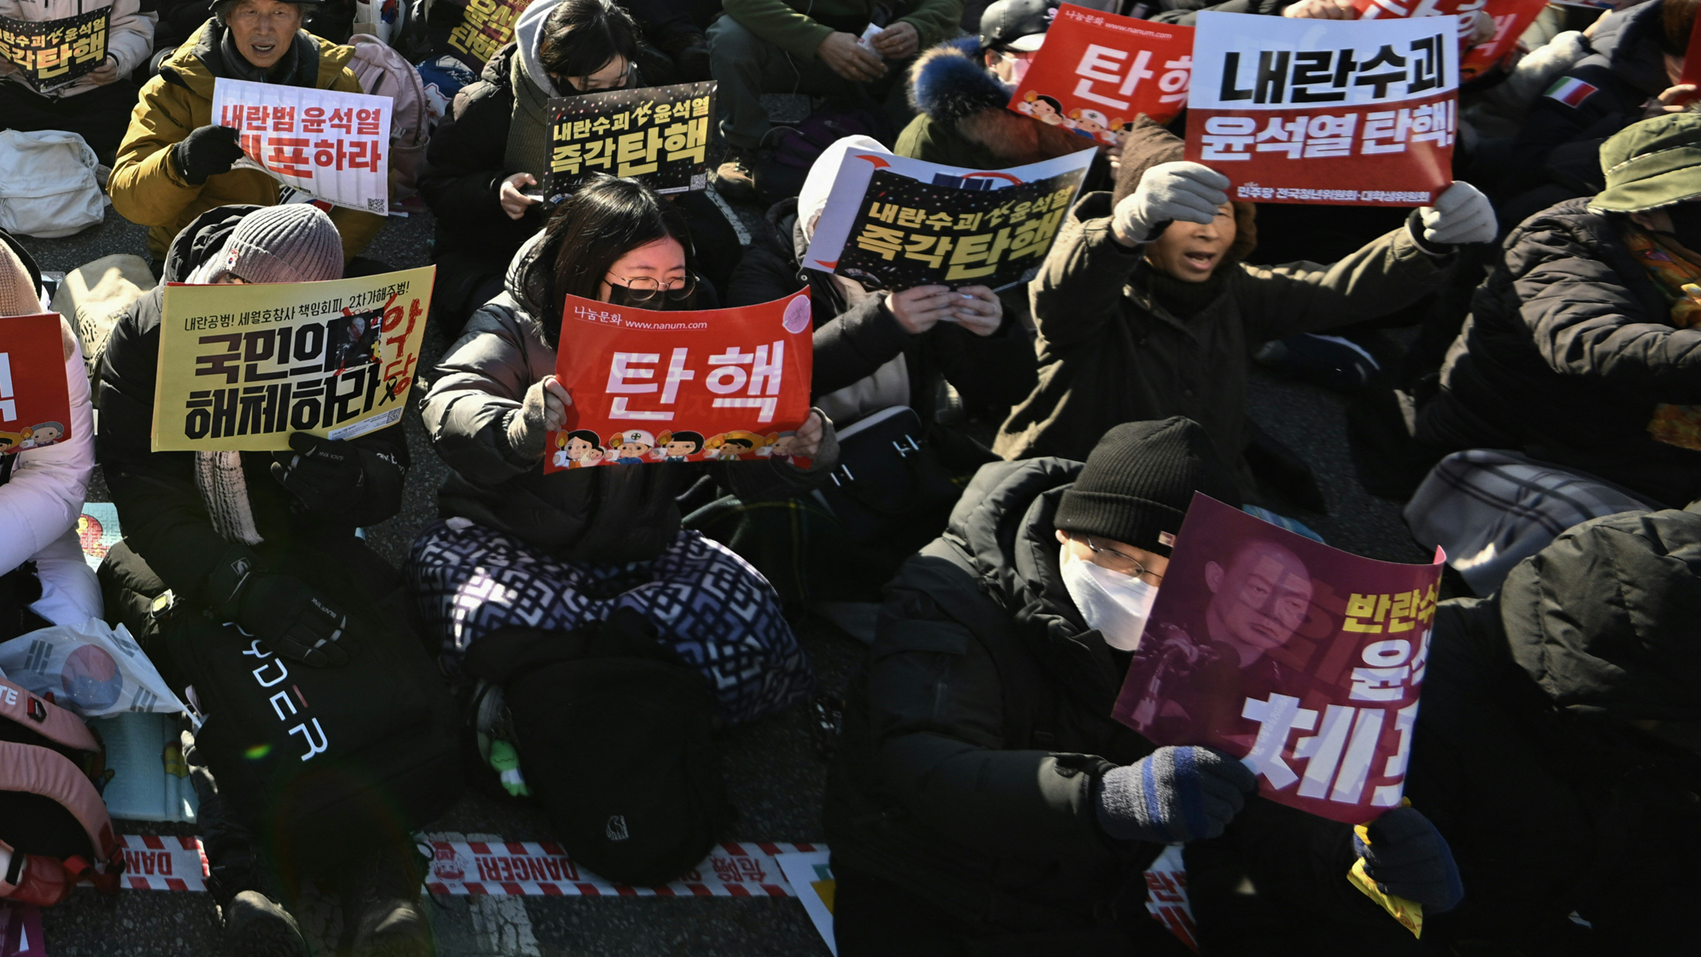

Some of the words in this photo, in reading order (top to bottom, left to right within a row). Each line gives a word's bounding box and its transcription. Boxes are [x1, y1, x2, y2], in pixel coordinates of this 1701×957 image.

[1065, 8, 1103, 29] 나눔문화
[1104, 21, 1173, 42] www.nanum.com
[1218, 32, 1446, 107] 내란수괴
[220, 104, 295, 136] 내란범
[301, 106, 382, 134] 윤석열
[552, 111, 631, 143] 내란수괴
[652, 95, 710, 126] 윤석열
[1199, 113, 1356, 162] 윤석열
[1362, 99, 1455, 155] 탄핵!
[867, 199, 985, 233] 내란수괴
[184, 314, 235, 331] 내란공범!
[237, 307, 295, 327] 세월호참사
[349, 281, 410, 309] 2차가해주범!
[573, 304, 623, 326] 나눔문화
[625, 318, 709, 332] www.nanum.com
[184, 363, 381, 440] 해체하라
[604, 339, 786, 424] 탄핵
[478, 852, 579, 882] DANGER!
